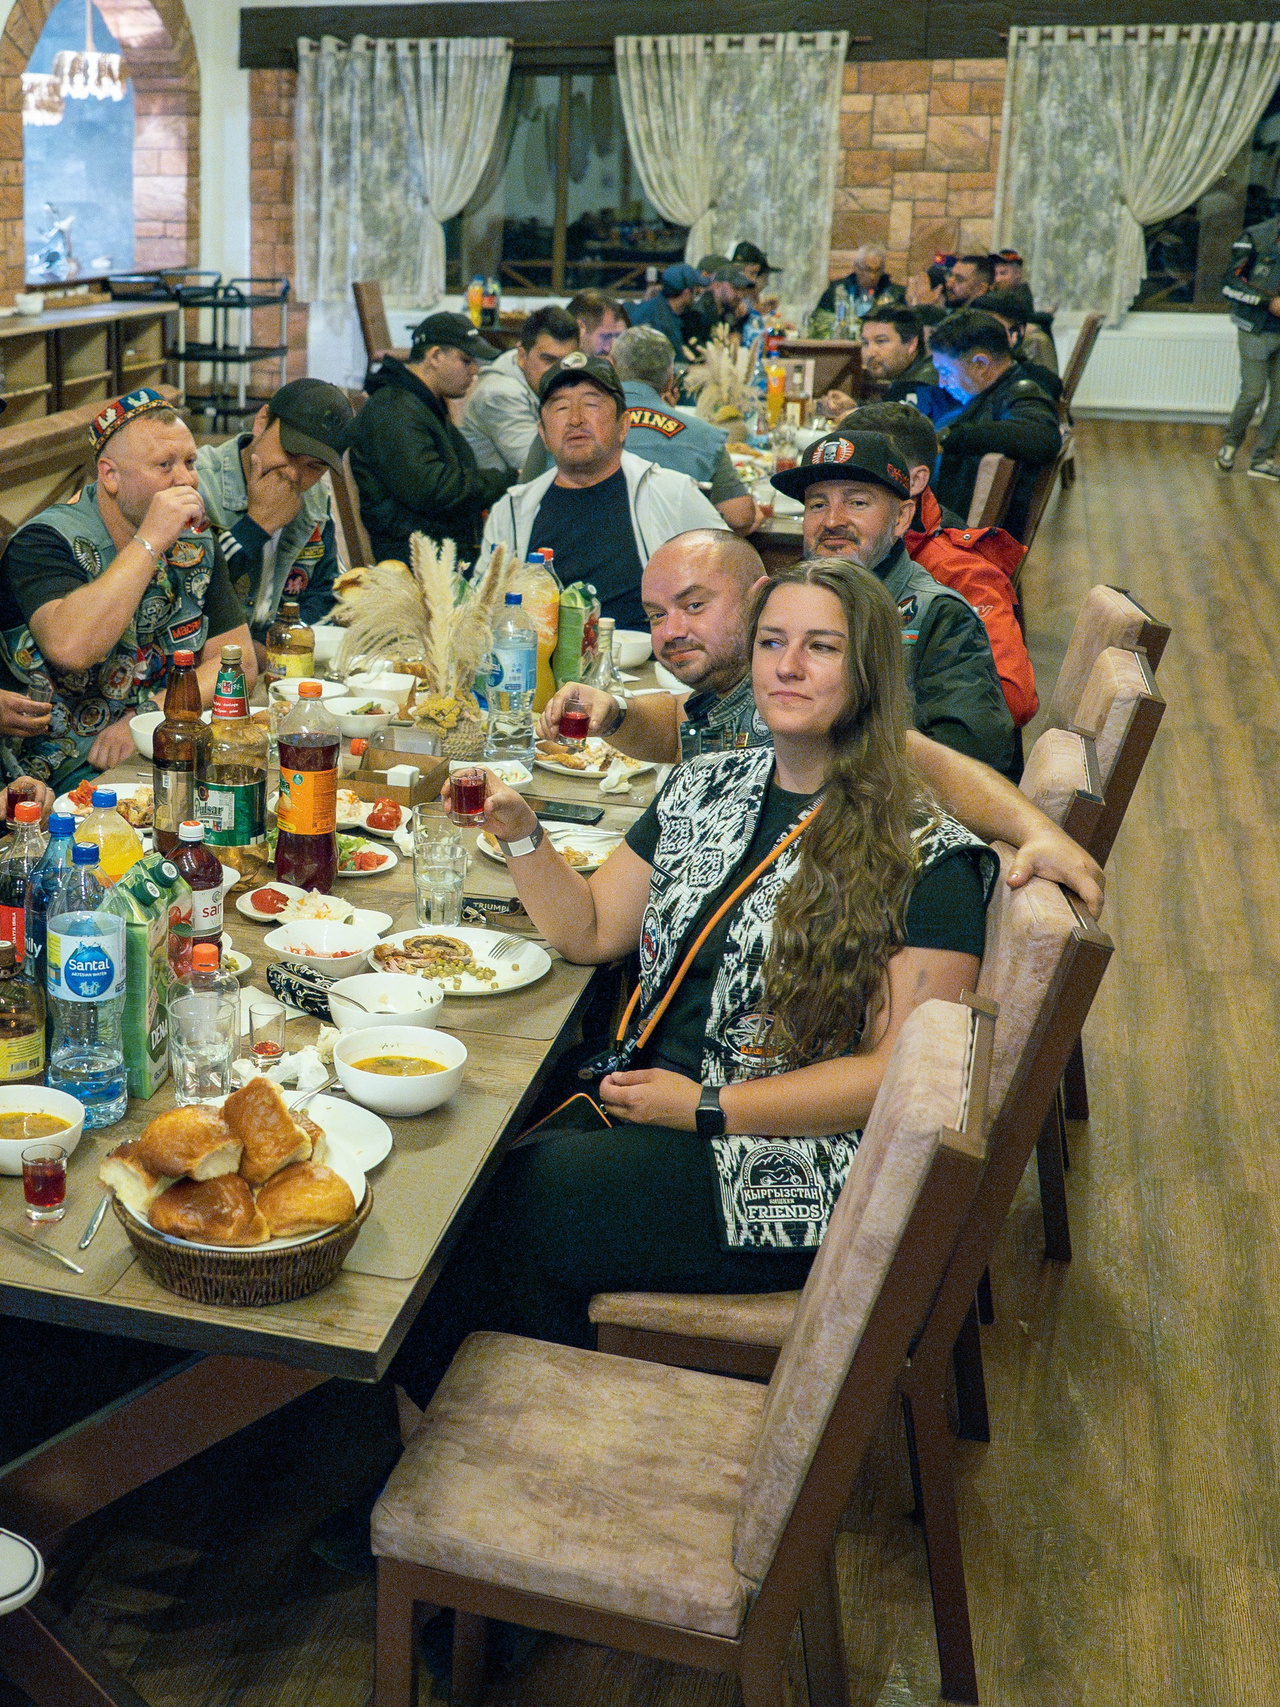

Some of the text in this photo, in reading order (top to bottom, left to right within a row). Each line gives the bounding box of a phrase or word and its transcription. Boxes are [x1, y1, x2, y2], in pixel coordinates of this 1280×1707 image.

[194, 798, 224, 817] Pulsar
[68, 958, 110, 971] Santal
[744, 1187, 819, 1202] КЫРГЫЗСТАН
[747, 1204, 820, 1219] FRIENDS
